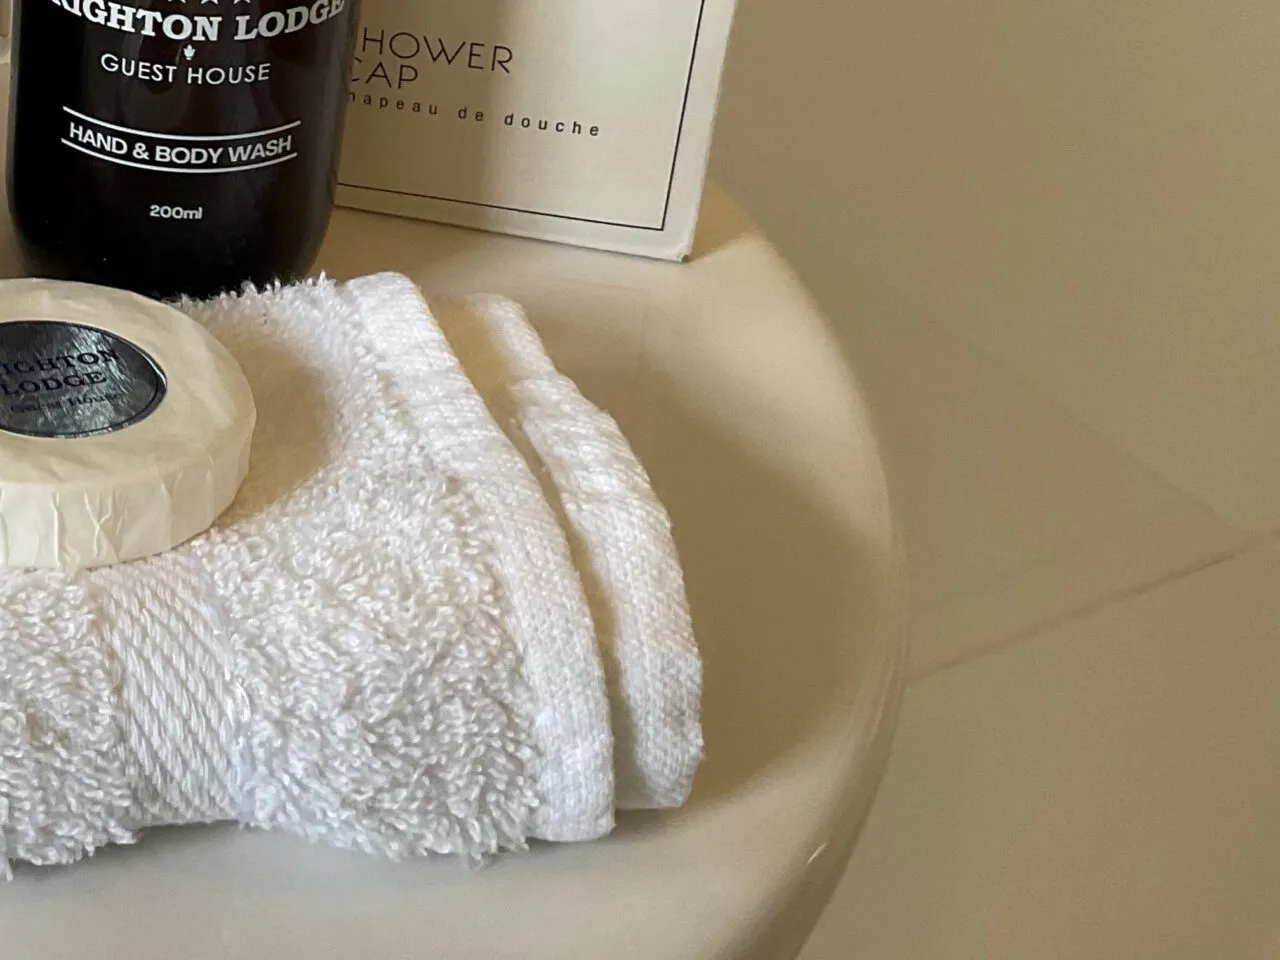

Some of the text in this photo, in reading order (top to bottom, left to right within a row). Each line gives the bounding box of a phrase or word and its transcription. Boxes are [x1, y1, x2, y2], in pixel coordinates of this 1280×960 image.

[100, 52, 271, 85] GUEST HOUSE
[361, 27, 514, 74] HOWER
[349, 91, 600, 137] apeau de douche
[69, 121, 293, 165] HAND & BODY WASH
[149, 203, 204, 220] 200ml
[0, 371, 108, 396] LODGE
